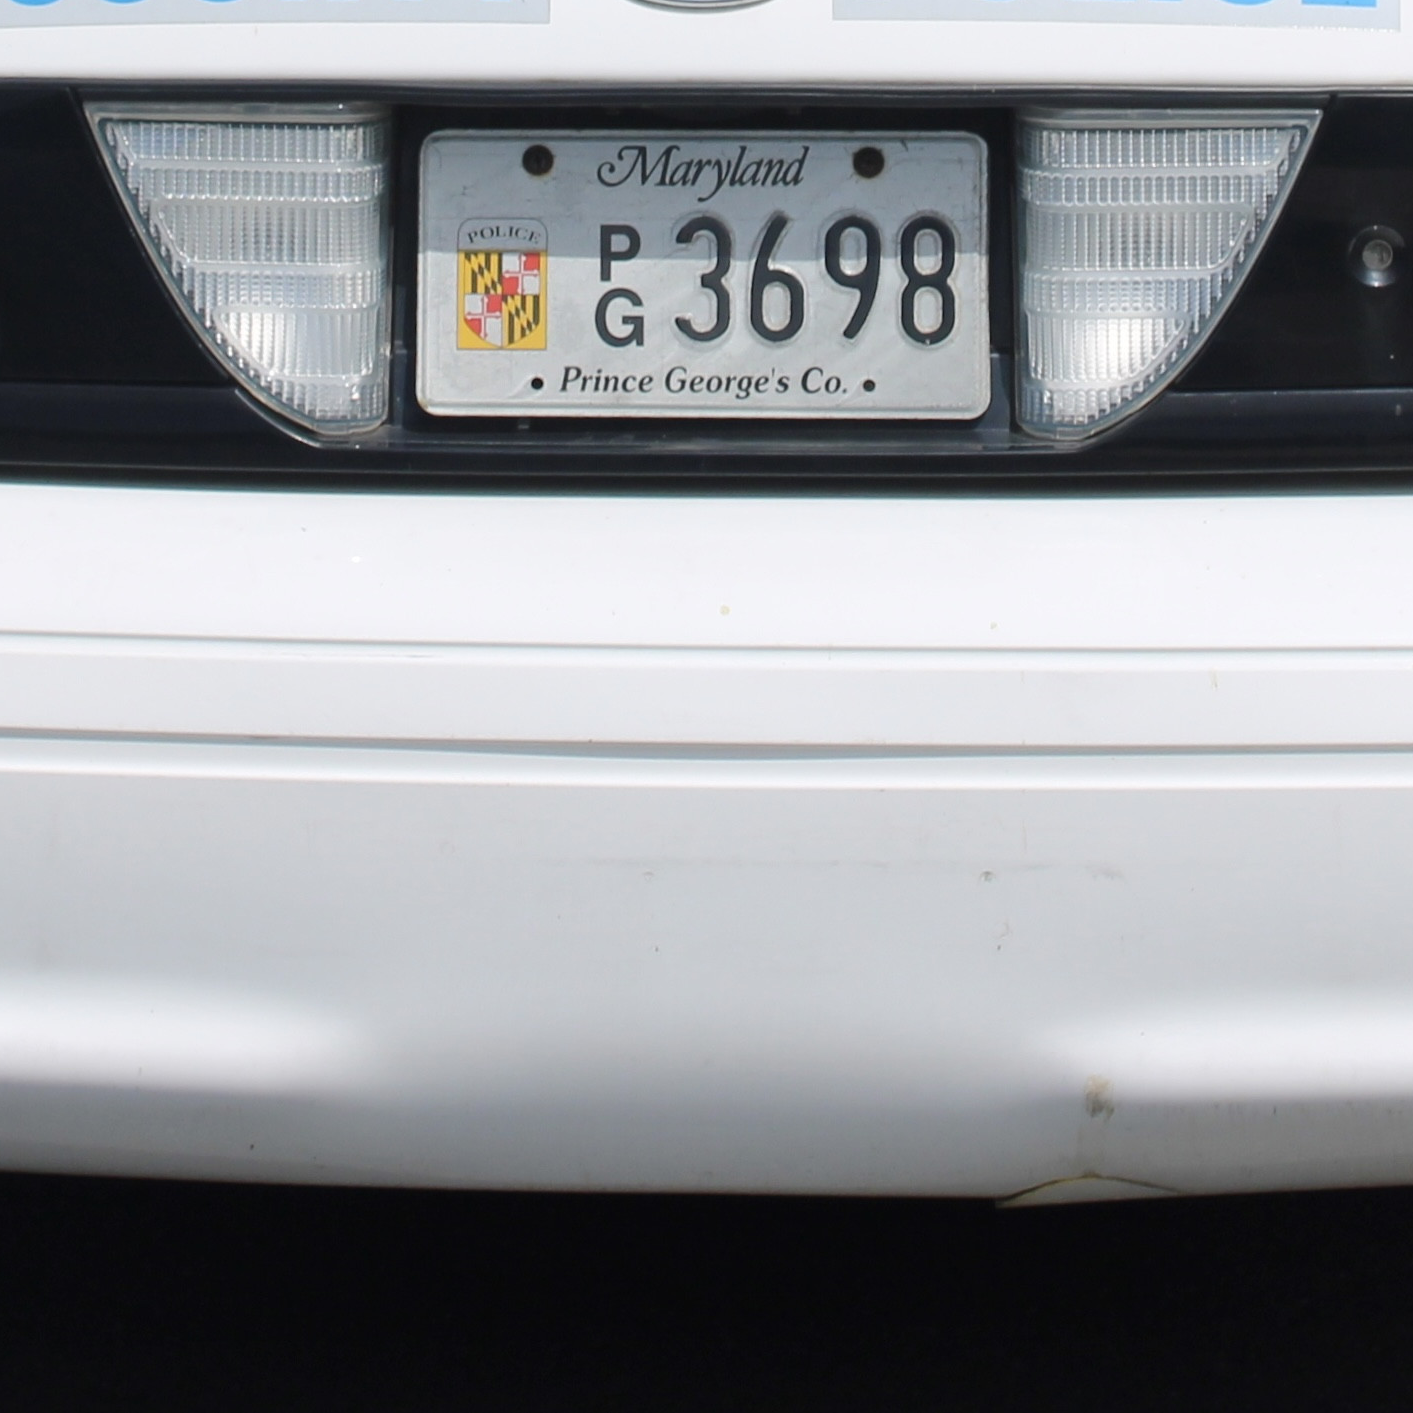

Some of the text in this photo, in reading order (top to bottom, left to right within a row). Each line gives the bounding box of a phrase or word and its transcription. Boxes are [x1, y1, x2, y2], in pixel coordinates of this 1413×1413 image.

[596, 145, 810, 202] Maryland
[467, 225, 542, 245] POLICE
[674, 215, 957, 346] 3698
[559, 366, 848, 399] Prince George's Co.
